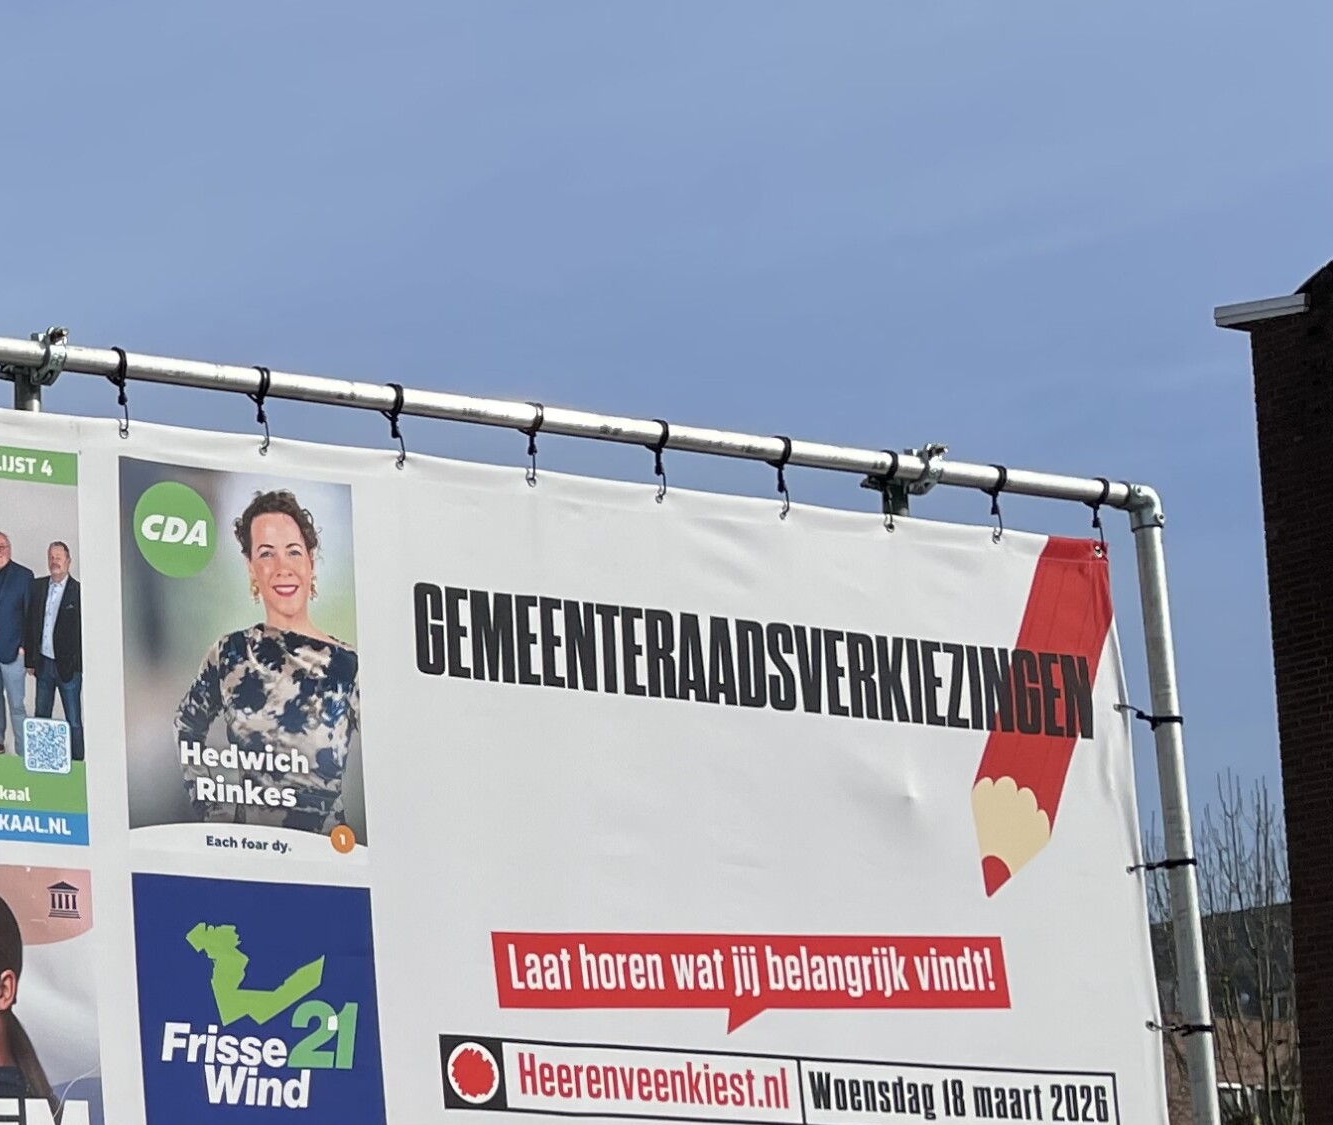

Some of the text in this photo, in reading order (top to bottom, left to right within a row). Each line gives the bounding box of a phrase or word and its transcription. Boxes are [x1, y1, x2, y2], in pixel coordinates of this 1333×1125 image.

[40, 457, 53, 477] 4
[141, 514, 208, 547] CDA
[413, 581, 1094, 739] GEMEENTERAADSVERKIEZINGEN
[180, 740, 309, 774] Hedwich
[196, 776, 297, 807] Rinkes
[206, 834, 292, 854] Each foar dy.
[339, 834, 347, 845] 1
[507, 943, 994, 1000] Laat horen wat jij belangrijk vindt!
[162, 1000, 358, 1070] Frisse 21
[205, 1064, 310, 1109] Wind
[517, 1052, 789, 1109] Heerenveenkiest.nl
[808, 1079, 1108, 1123] Woensdag 18 maart 2026
